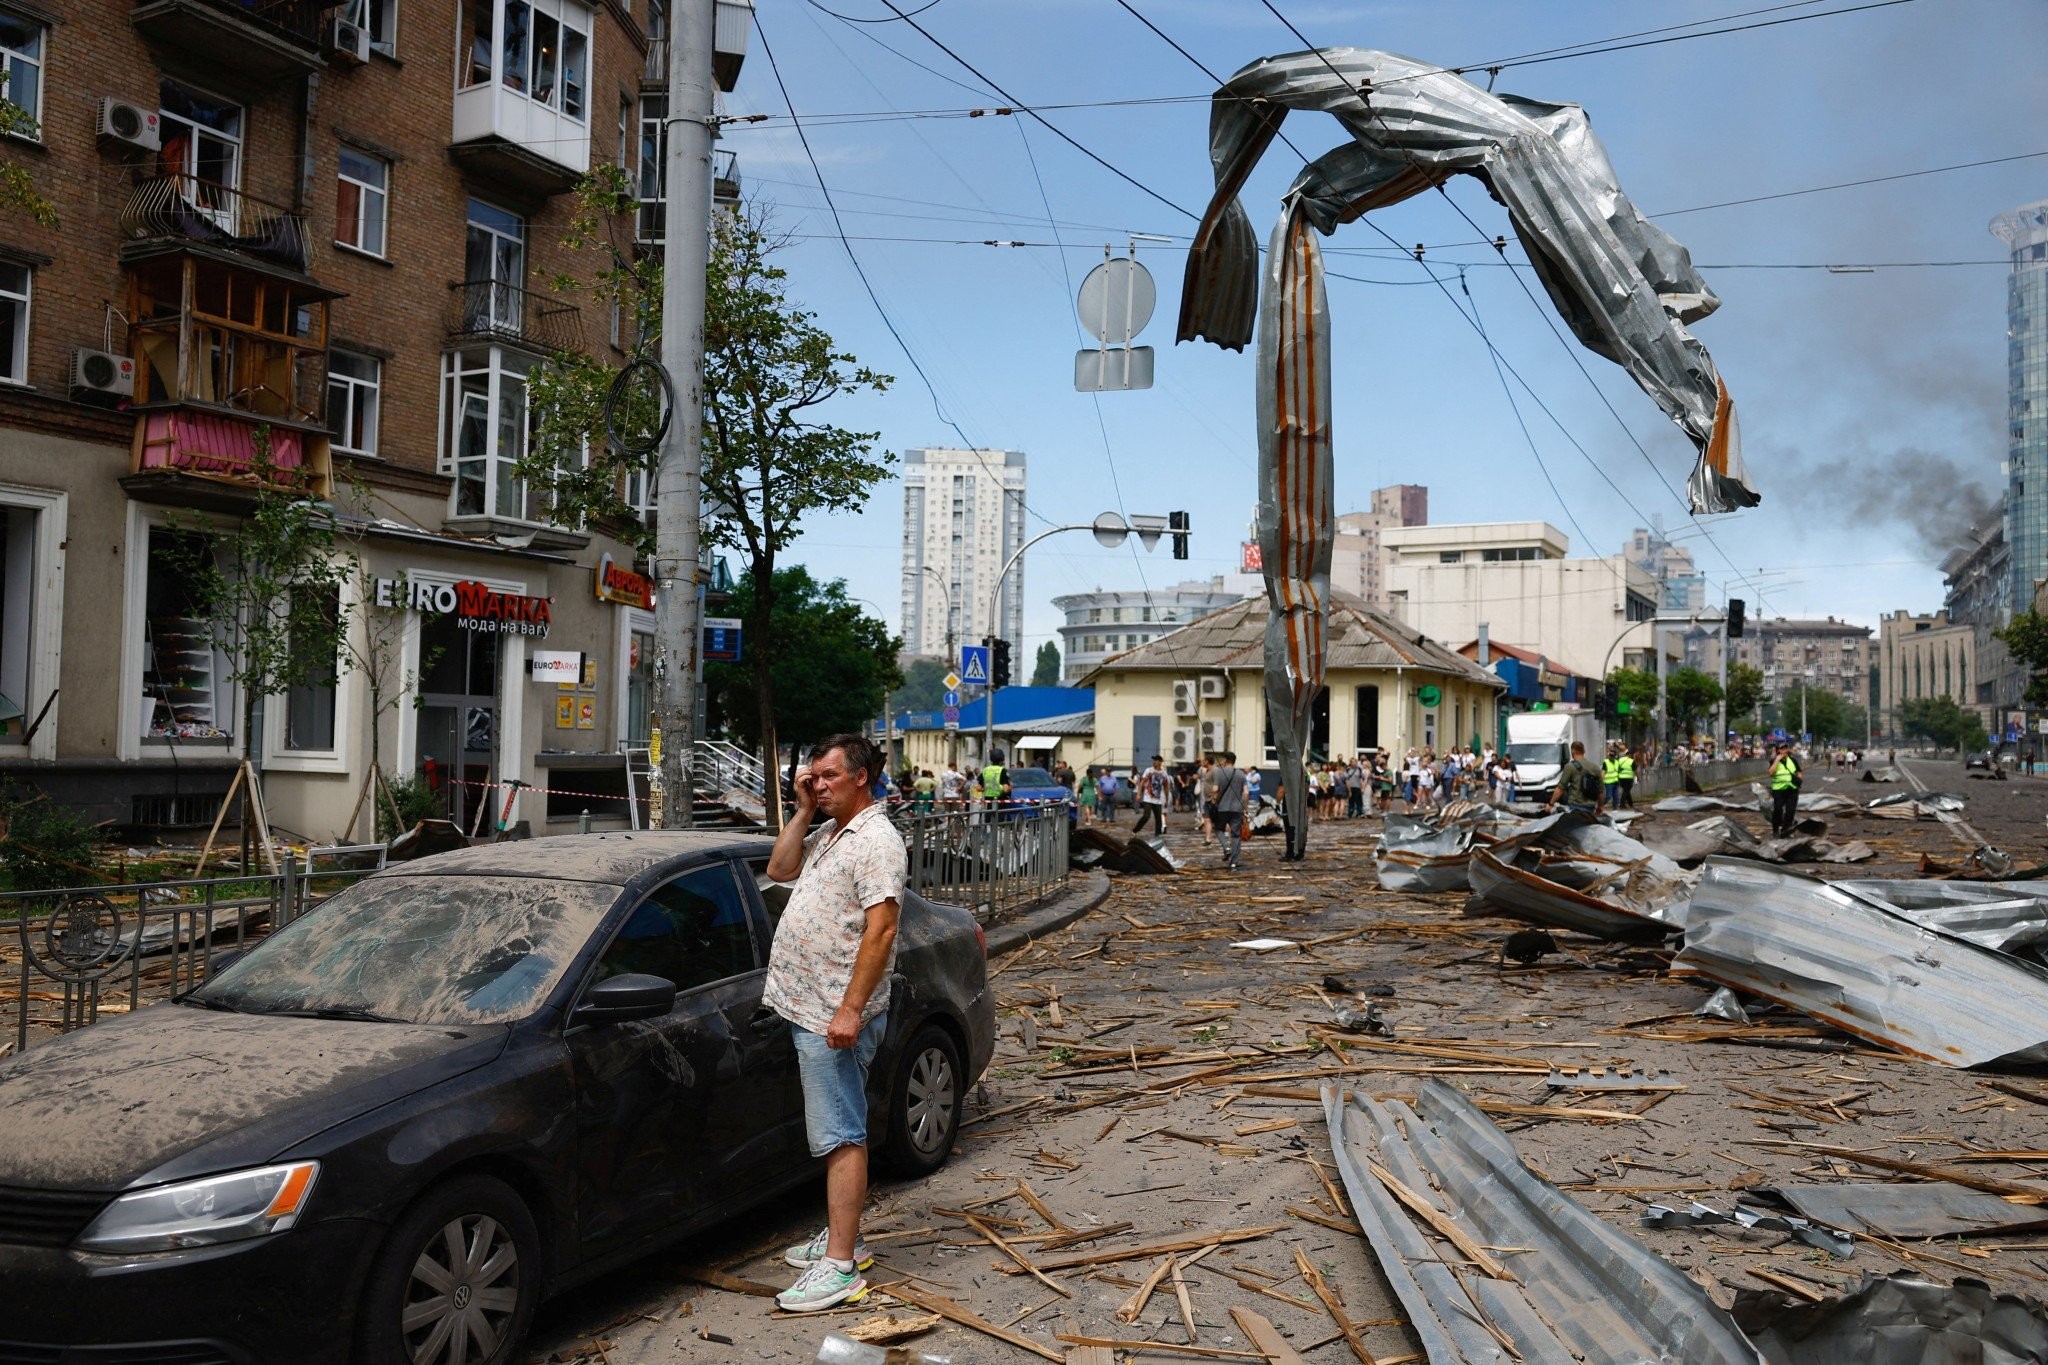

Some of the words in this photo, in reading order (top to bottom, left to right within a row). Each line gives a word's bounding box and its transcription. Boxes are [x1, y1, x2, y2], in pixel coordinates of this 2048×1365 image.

[603, 560, 643, 595] АВРОРА
[457, 617, 496, 633] мода
[500, 621, 517, 635] на
[521, 624, 550, 640] вагу
[533, 660, 579, 671] EUROMARKA
